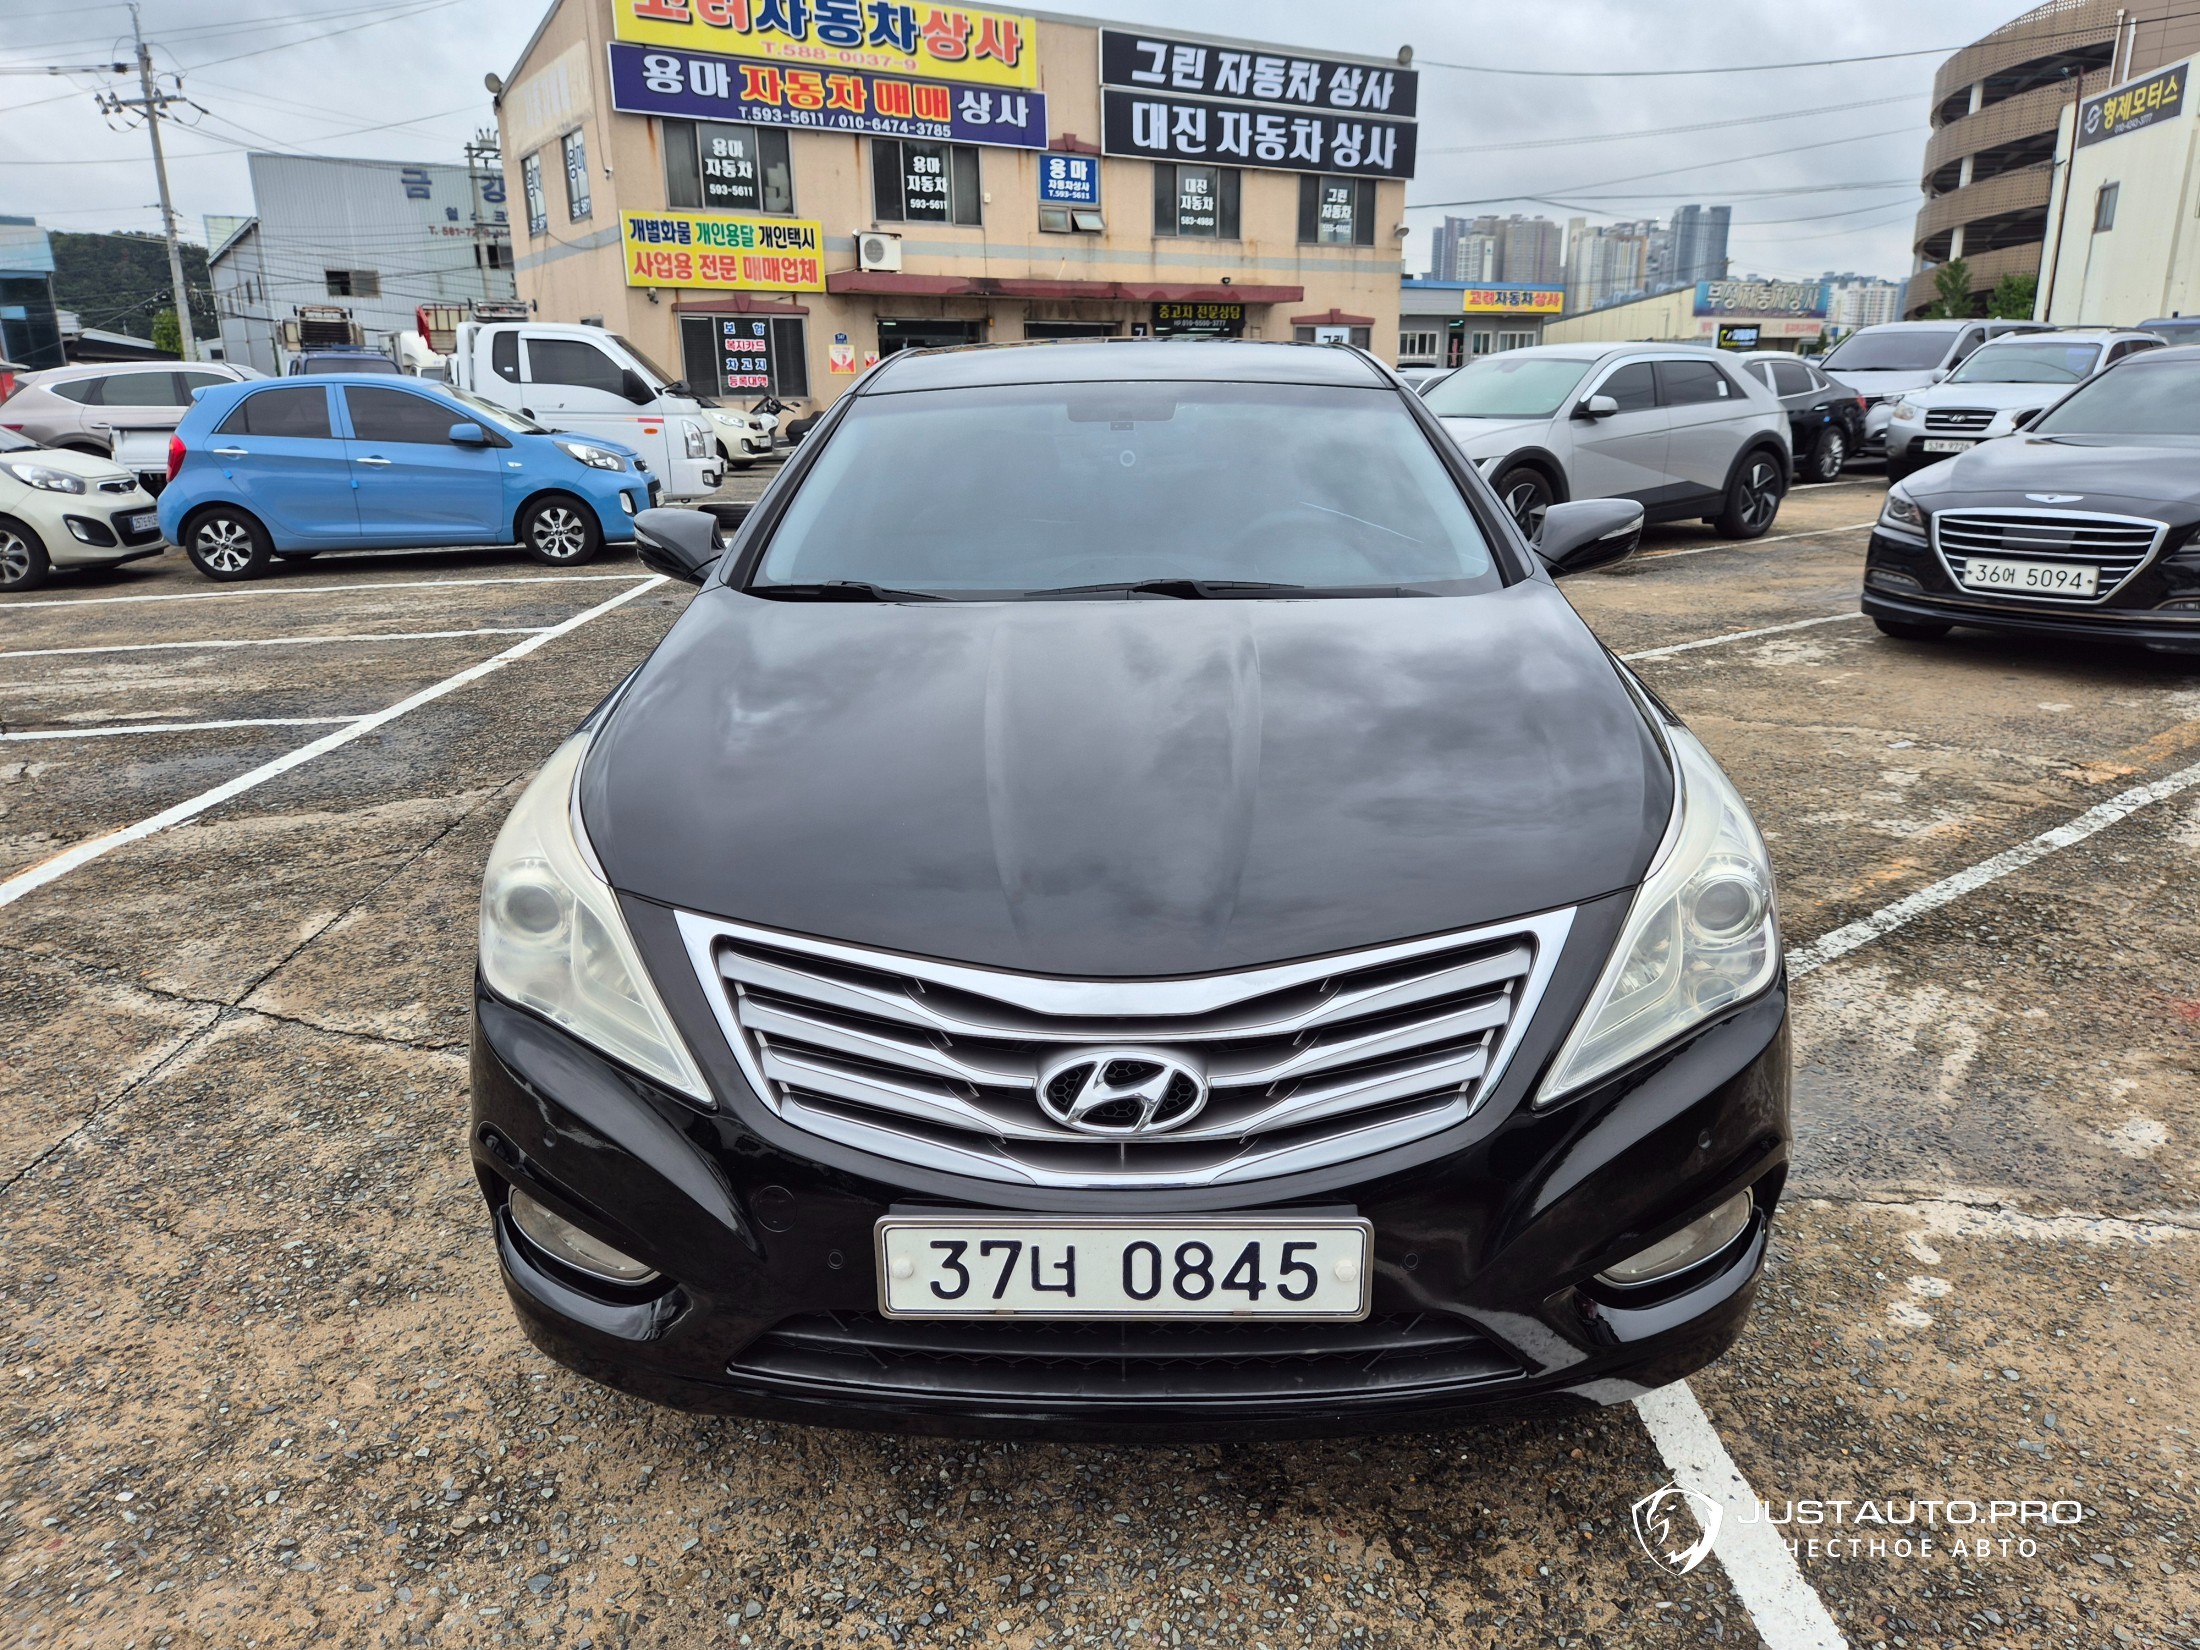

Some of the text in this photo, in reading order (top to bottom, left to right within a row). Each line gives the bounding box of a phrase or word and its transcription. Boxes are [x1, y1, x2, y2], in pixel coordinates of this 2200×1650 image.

[1132, 40, 1395, 111] 그린 자동차 상사
[642, 54, 1029, 128] 용마 자동차 매매 상사
[2104, 75, 2178, 129] 형제모터스
[738, 105, 825, 126] T.593-5611
[838, 114, 952, 137] 010-6474-3785
[1132, 102, 1398, 170] 대진 자동차 상사
[712, 137, 744, 158] 용마
[705, 158, 753, 179] 자동차
[912, 156, 941, 174] 용마
[709, 183, 753, 197] 593-5611
[906, 175, 948, 193] 자동차
[1185, 178, 1208, 194] 대진
[910, 198, 948, 210] 593-5611
[1180, 195, 1214, 212] 자동차
[1327, 188, 1348, 203] 그린
[1321, 204, 1352, 219] 자동차
[628, 218, 815, 250] 개별화물 개인용달 개인택시
[634, 251, 818, 285] 사업용 전문 매매업체
[1160, 304, 1193, 319] 중고차
[725, 338, 767, 352] 복지카드
[728, 374, 769, 388] 등록대행
[1975, 563, 2083, 590] 36어 5094
[928, 1239, 1320, 1301] 37너 0845
